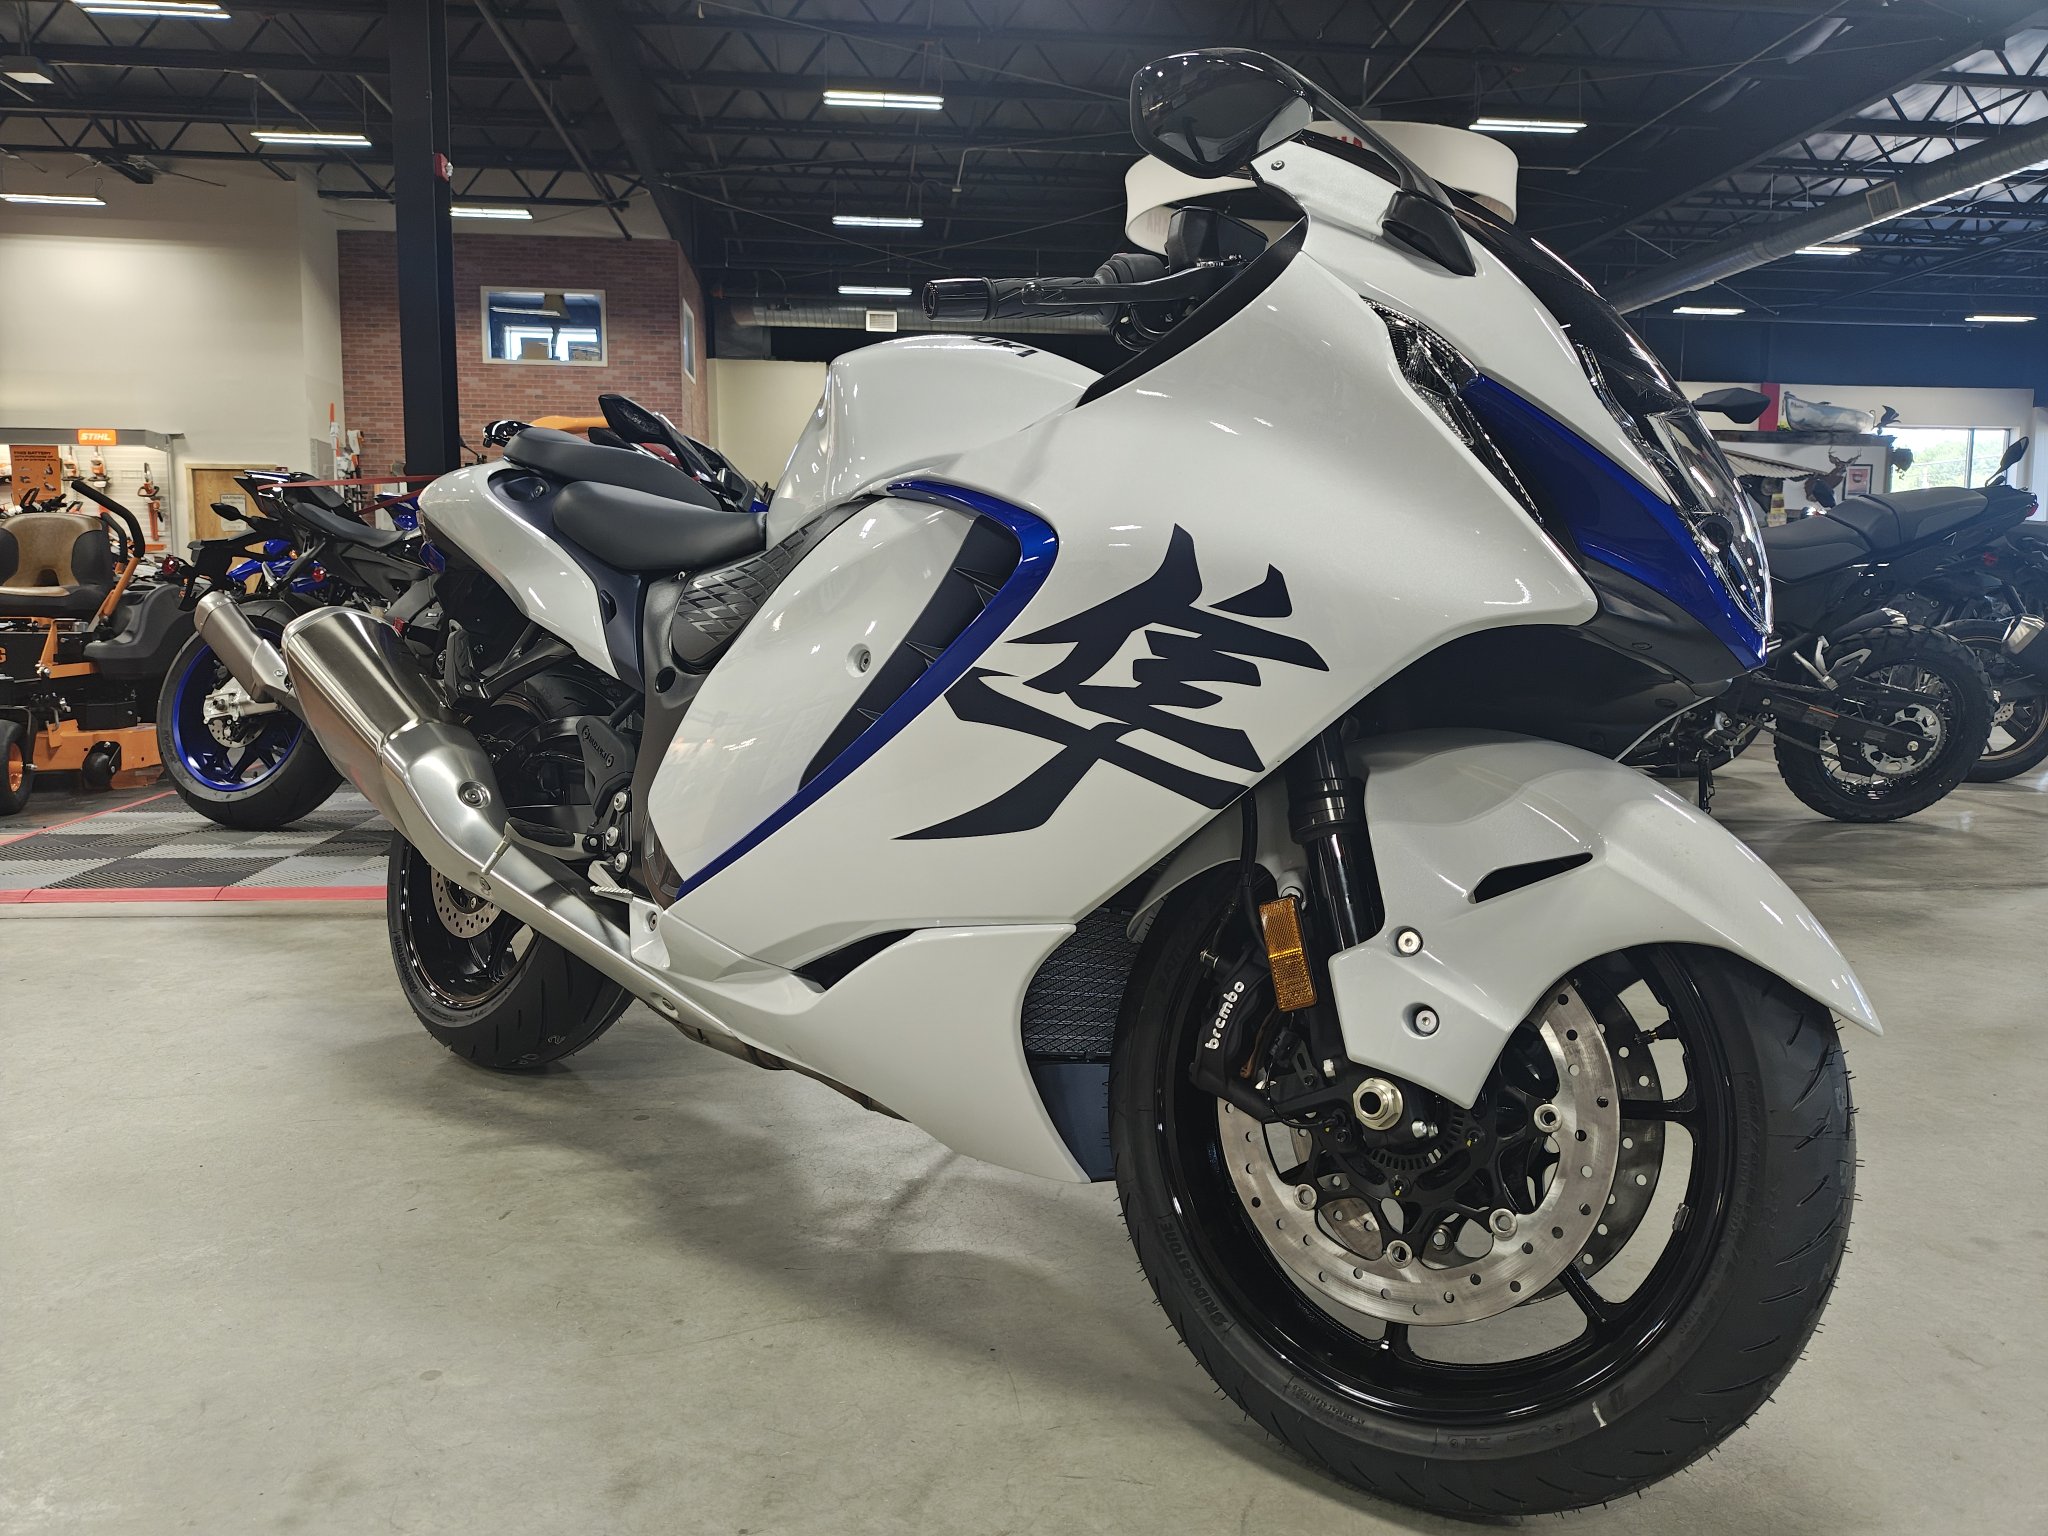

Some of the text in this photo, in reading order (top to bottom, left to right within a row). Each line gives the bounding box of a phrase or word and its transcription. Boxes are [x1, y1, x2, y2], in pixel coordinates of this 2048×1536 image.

[80, 432, 112, 441] STIHL
[892, 523, 1329, 840] 隼
[1205, 981, 1245, 1050] brembo
[1160, 1222, 1230, 1328] BRIDGESTONE
